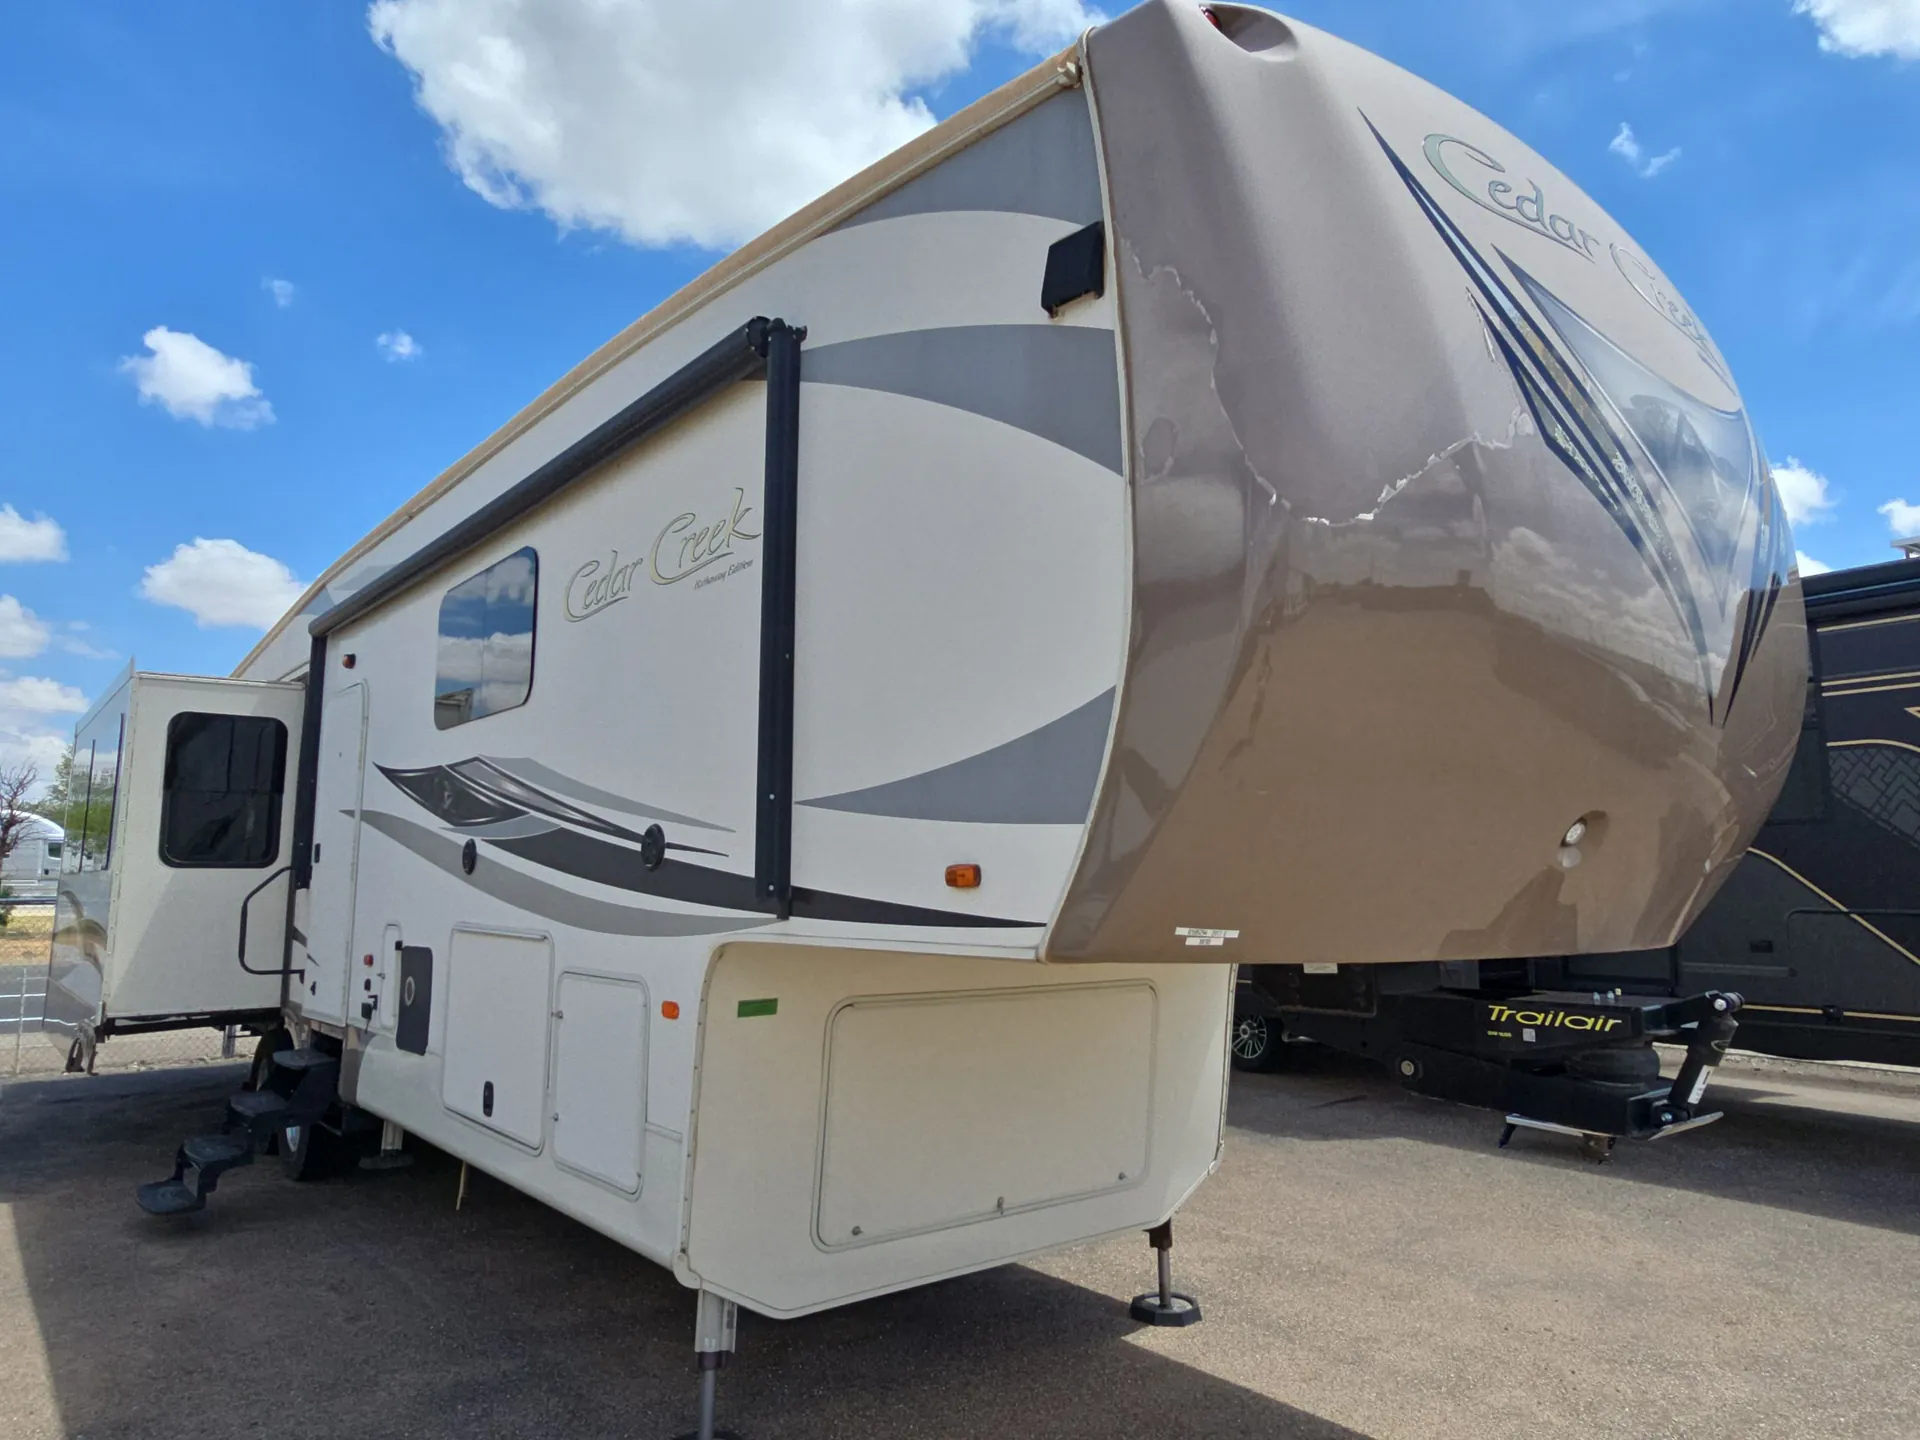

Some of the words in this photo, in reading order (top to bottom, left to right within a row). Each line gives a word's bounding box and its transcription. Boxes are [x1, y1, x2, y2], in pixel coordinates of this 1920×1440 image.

[1421, 133, 1600, 265] Cedar
[563, 549, 644, 623] Cedar
[650, 487, 762, 586] Creek
[1488, 1004, 1623, 1032] Trailair
